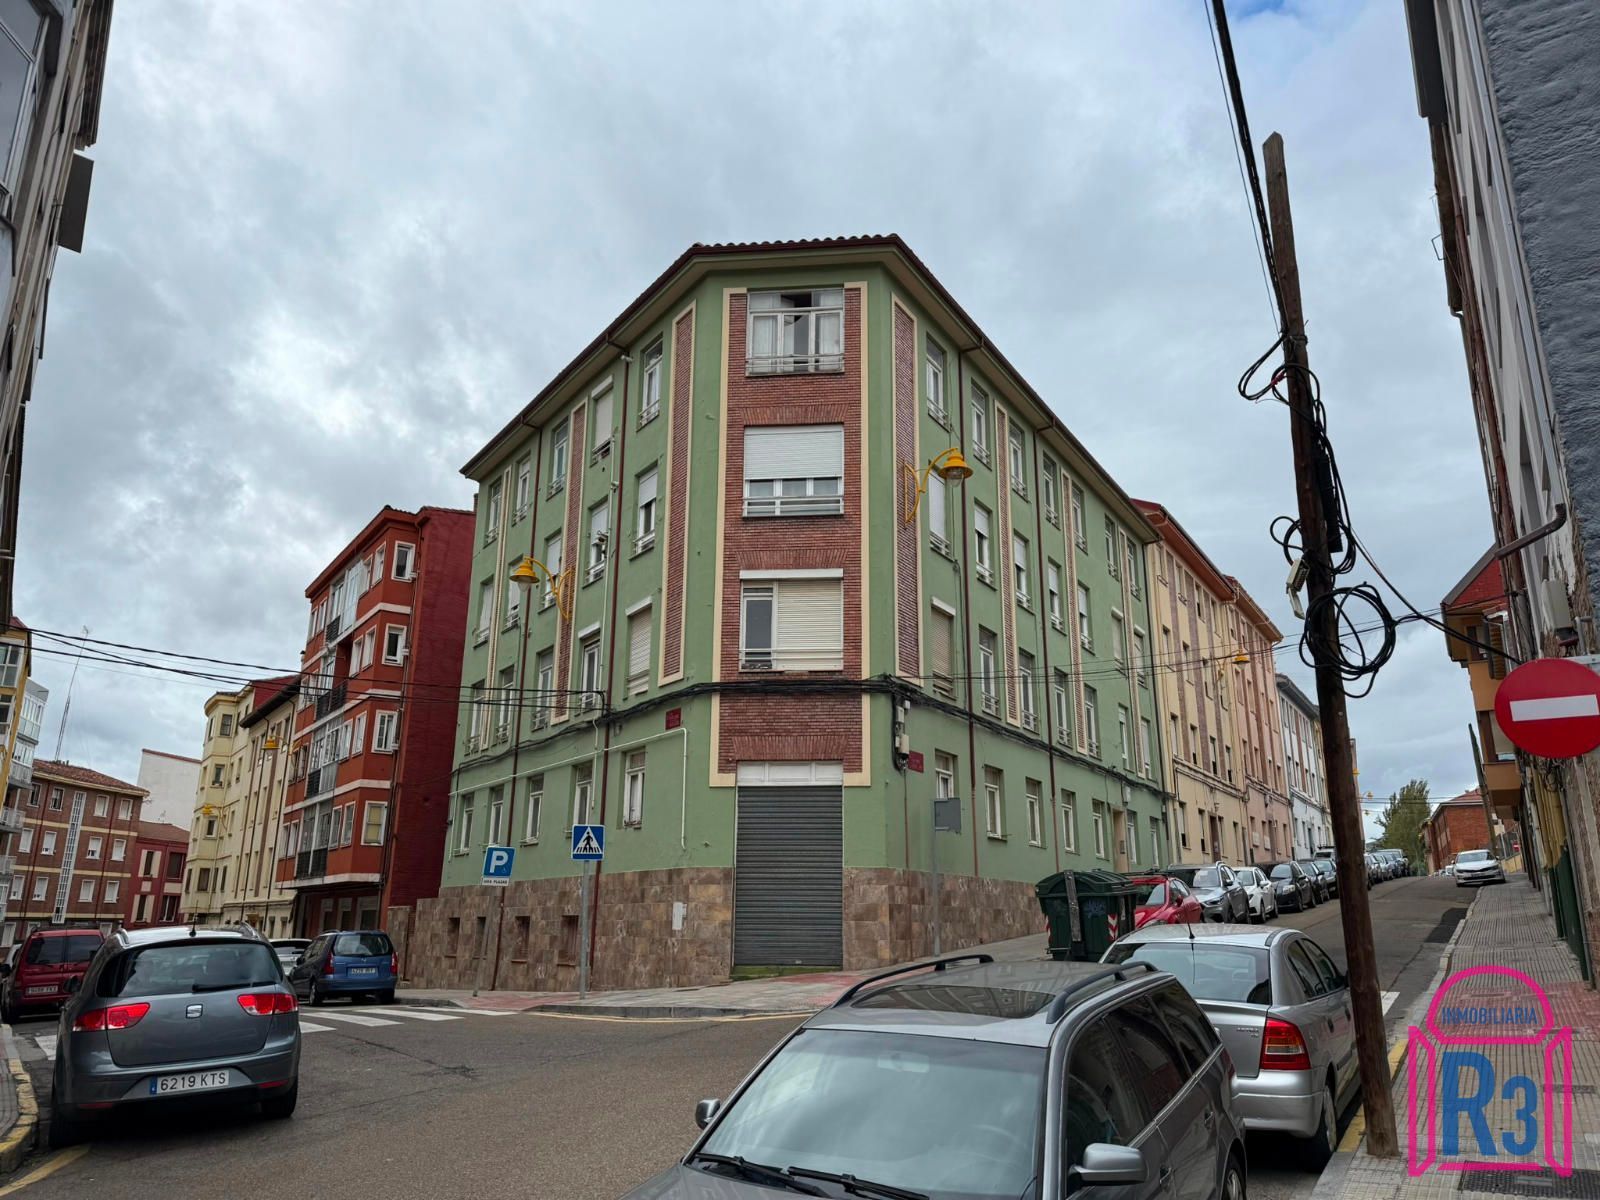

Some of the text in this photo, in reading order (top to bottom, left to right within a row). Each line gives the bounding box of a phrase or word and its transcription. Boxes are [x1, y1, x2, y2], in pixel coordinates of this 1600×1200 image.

[489, 850, 509, 873] P
[160, 1072, 226, 1091] 6219 KTS
